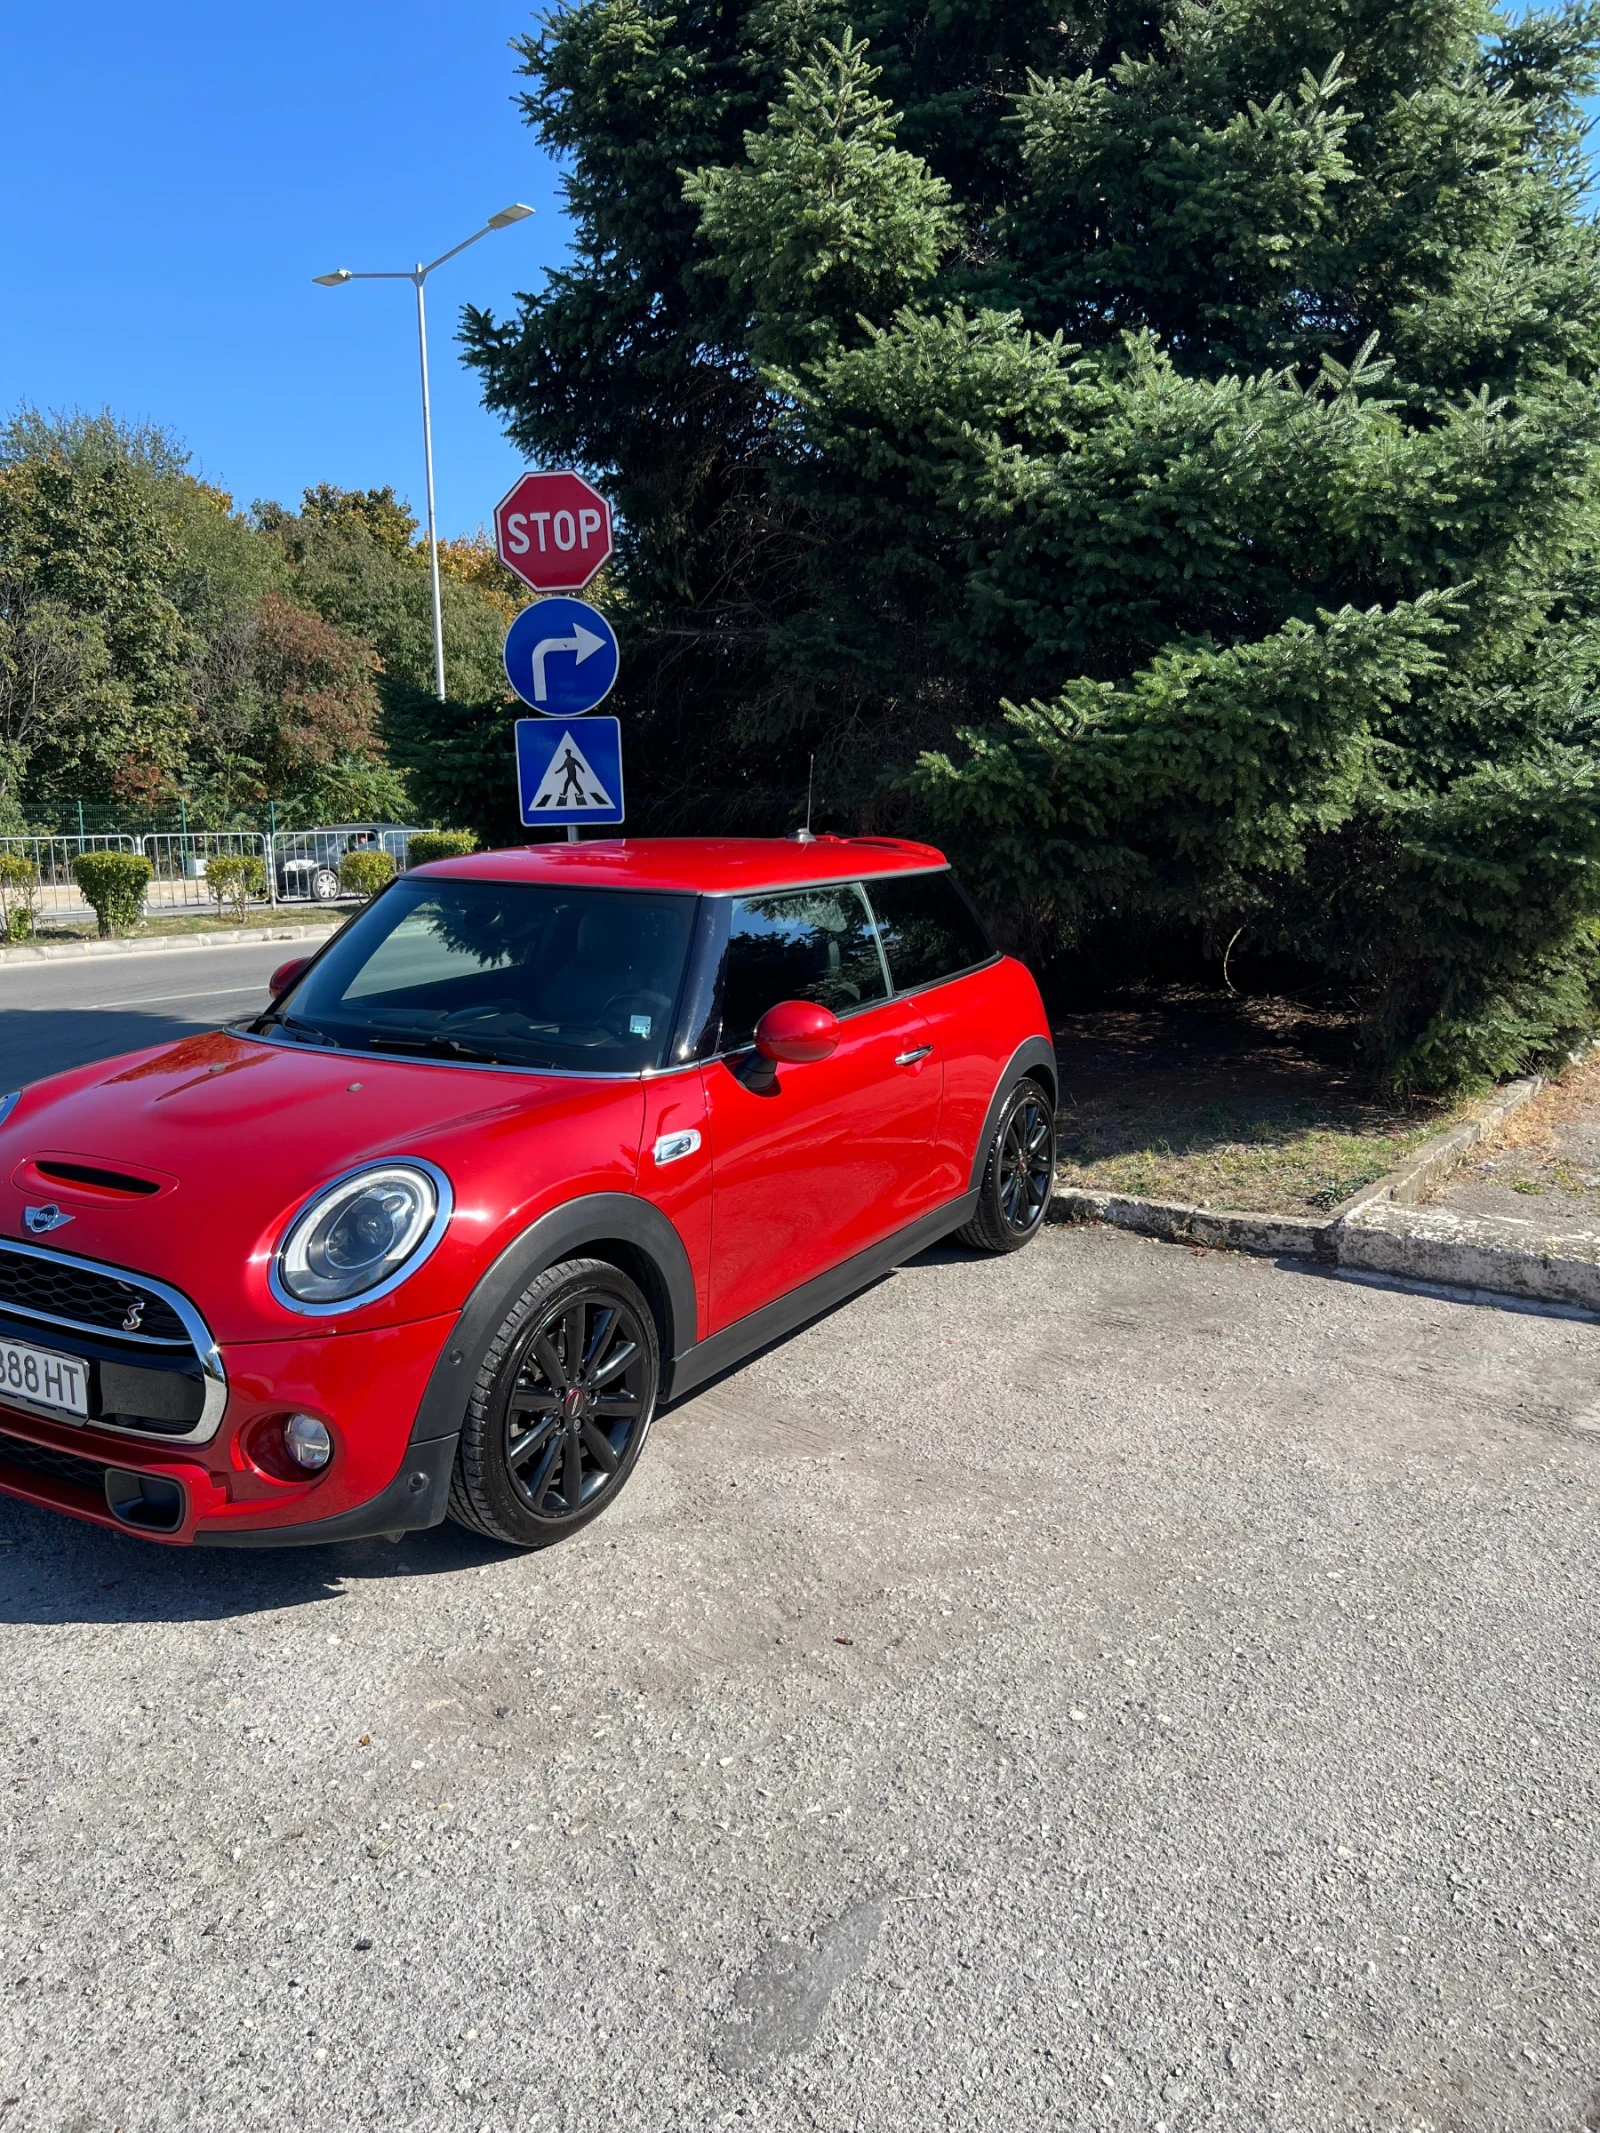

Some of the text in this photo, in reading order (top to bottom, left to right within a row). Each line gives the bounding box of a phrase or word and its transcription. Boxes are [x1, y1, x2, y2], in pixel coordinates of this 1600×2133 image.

[507, 508, 601, 554] STOP
[36, 1212, 53, 1223] MINI
[122, 1302, 145, 1331] S
[44, 1359, 79, 1405] HT
